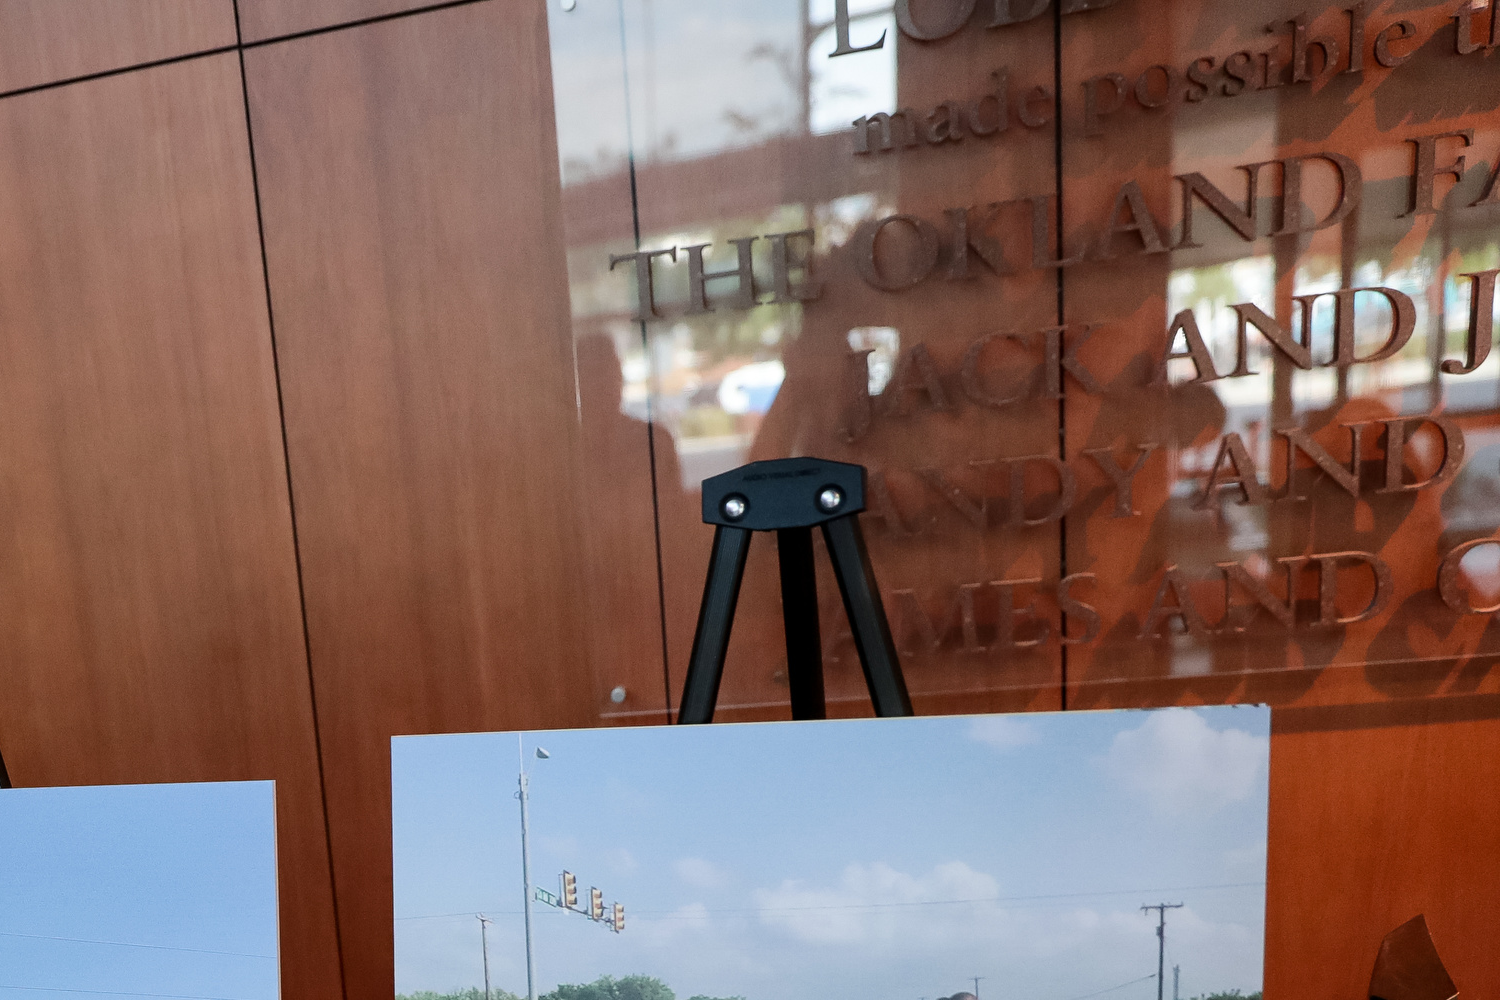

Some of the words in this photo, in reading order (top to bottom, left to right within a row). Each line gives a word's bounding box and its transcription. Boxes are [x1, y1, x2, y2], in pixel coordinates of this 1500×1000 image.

[852, 65, 1050, 156] made
[1080, 4, 1417, 140] possible
[609, 230, 822, 322] THE
[856, 152, 1363, 293] OKLAND
[840, 322, 1110, 444] JACK
[1152, 286, 1417, 386] AND
[1192, 413, 1466, 511] AND
[1136, 550, 1394, 640] AND
